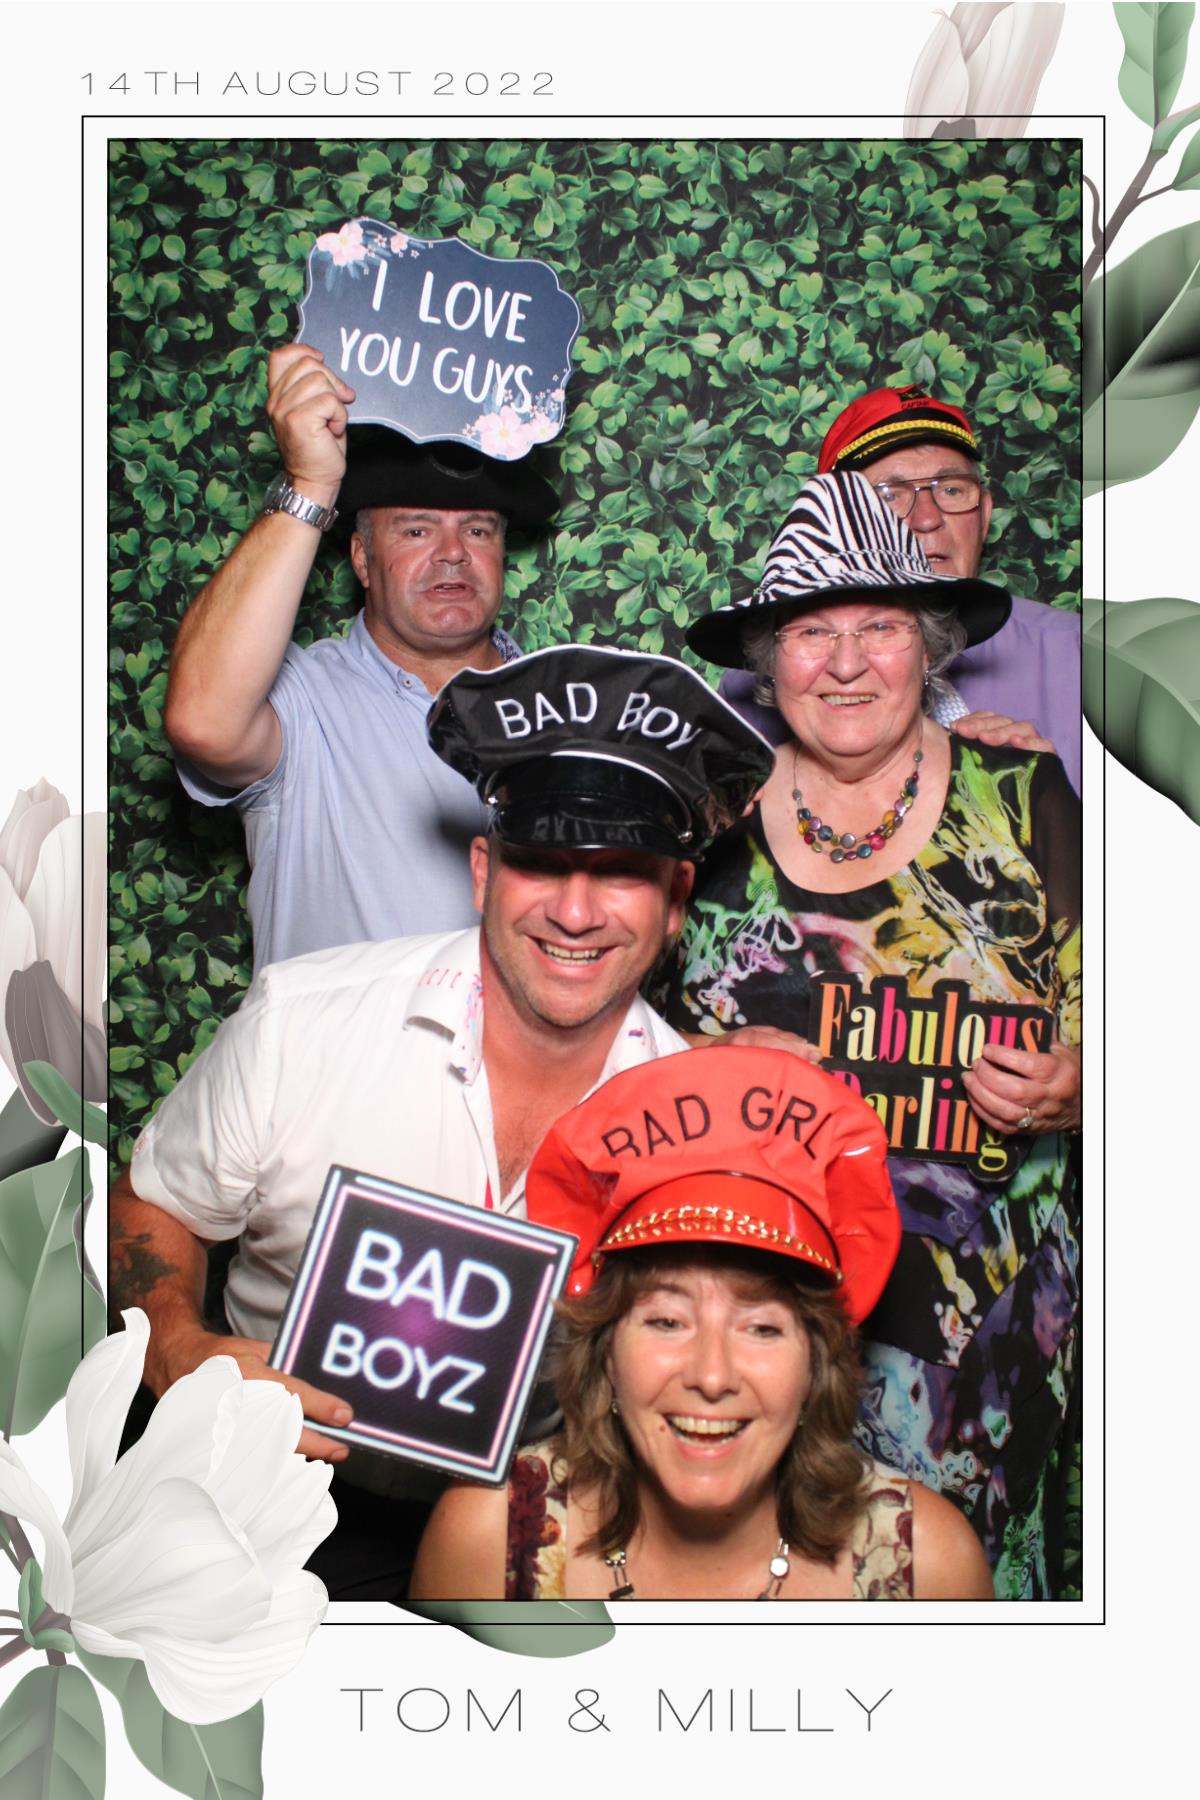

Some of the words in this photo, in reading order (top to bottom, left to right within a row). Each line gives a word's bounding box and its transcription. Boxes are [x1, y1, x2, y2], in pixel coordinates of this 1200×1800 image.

[371, 260, 388, 312] I
[419, 270, 532, 344] LOVE
[339, 326, 421, 387] YOU
[431, 348, 534, 413] GUYS
[494, 682, 598, 739] BAD
[617, 692, 703, 750] BOY
[818, 982, 1044, 1069] Fabulous
[741, 1086, 832, 1160] GRL
[345, 1229, 511, 1331] BAD
[320, 1323, 487, 1415] BOYZ
